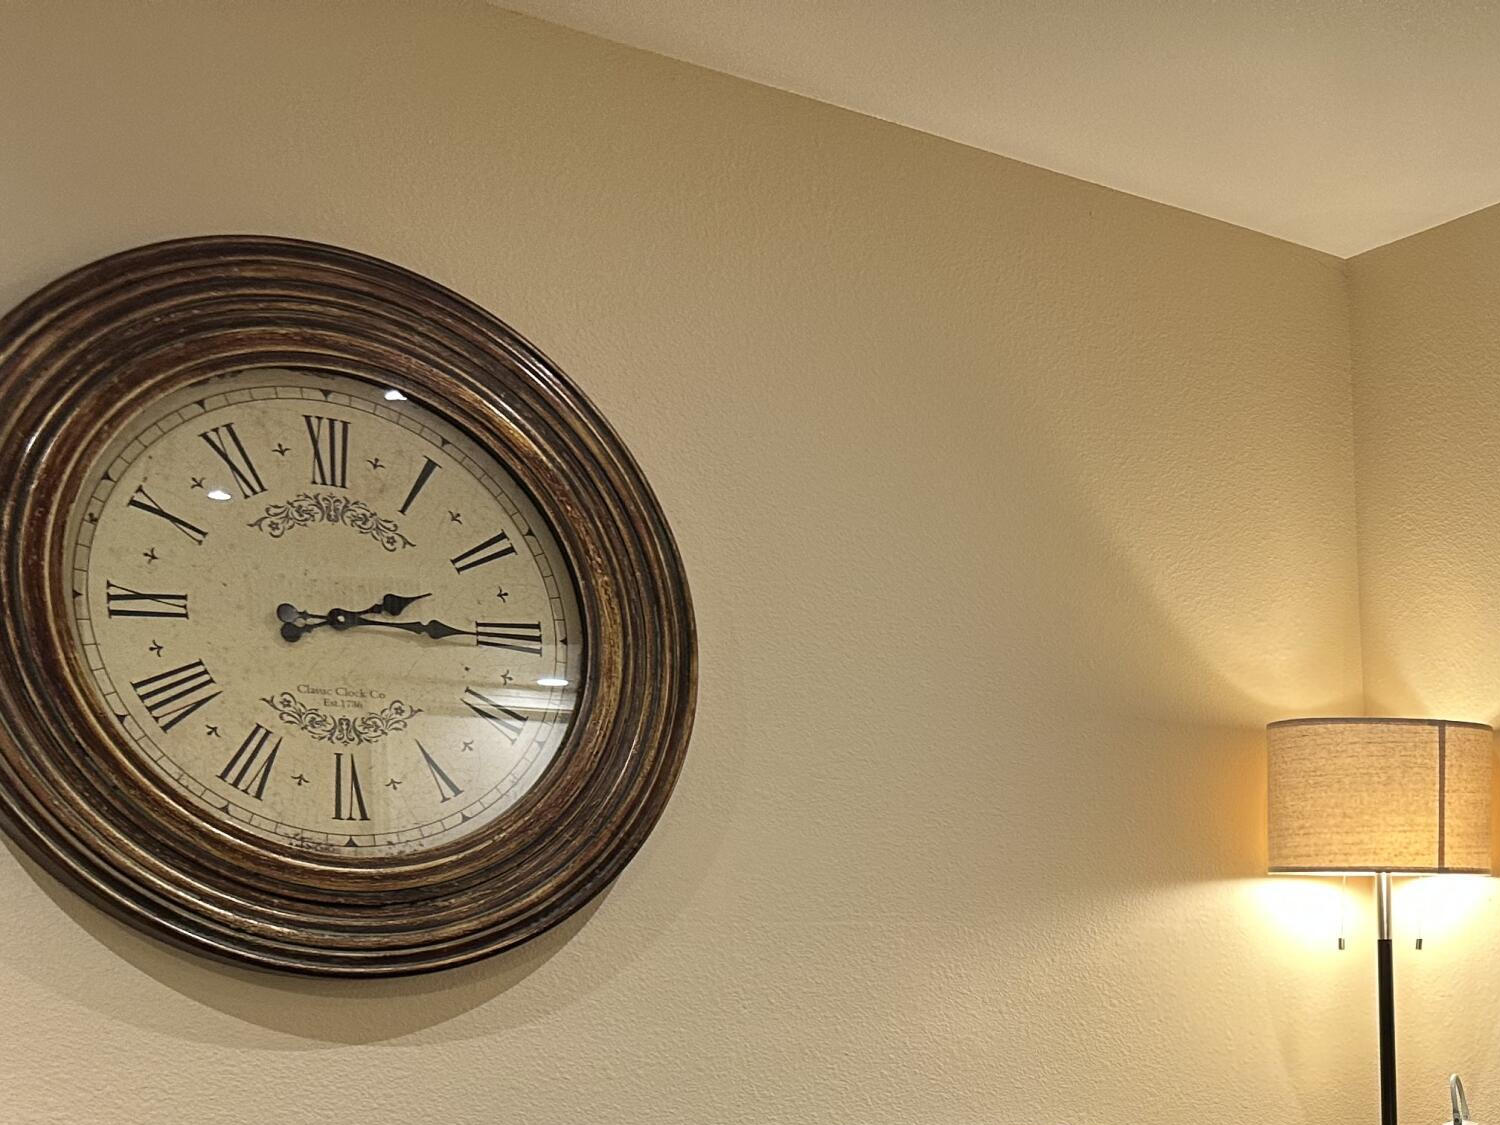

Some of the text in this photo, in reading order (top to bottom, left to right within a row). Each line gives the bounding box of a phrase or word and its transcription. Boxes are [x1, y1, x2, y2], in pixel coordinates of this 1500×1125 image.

[198, 422, 268, 499] XI
[302, 415, 351, 489] XII
[127, 485, 208, 545] X
[450, 529, 518, 575] II
[106, 580, 189, 619] IX
[335, 687, 367, 697] Clock
[216, 723, 283, 801] VII
[331, 752, 371, 820] VI
